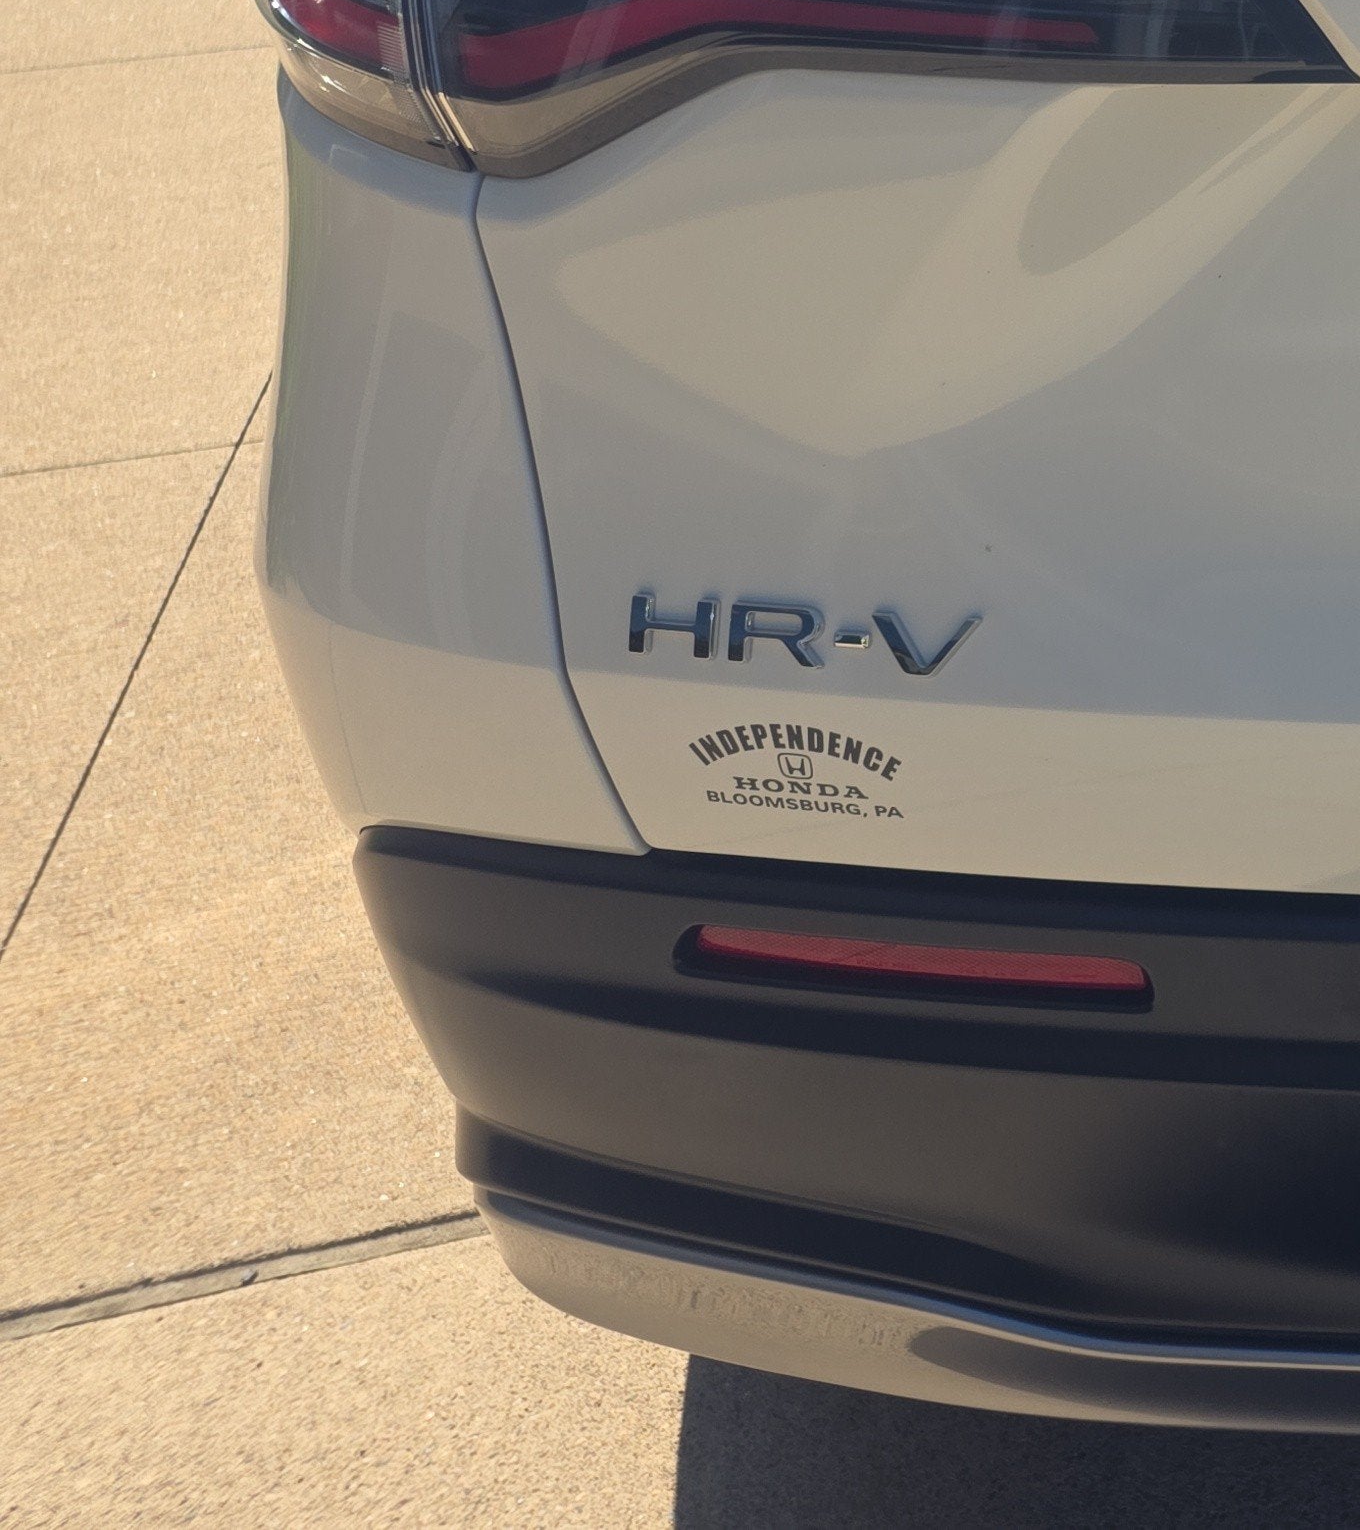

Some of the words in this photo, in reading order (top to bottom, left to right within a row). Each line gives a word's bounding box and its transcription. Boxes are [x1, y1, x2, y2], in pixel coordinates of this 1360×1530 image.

[628, 592, 983, 676] HR-V
[688, 722, 903, 782] INDEPENDENCE
[705, 789, 869, 818] BLOOMSBURG,
[873, 804, 905, 819] PA
[732, 775, 870, 800] HONDA
